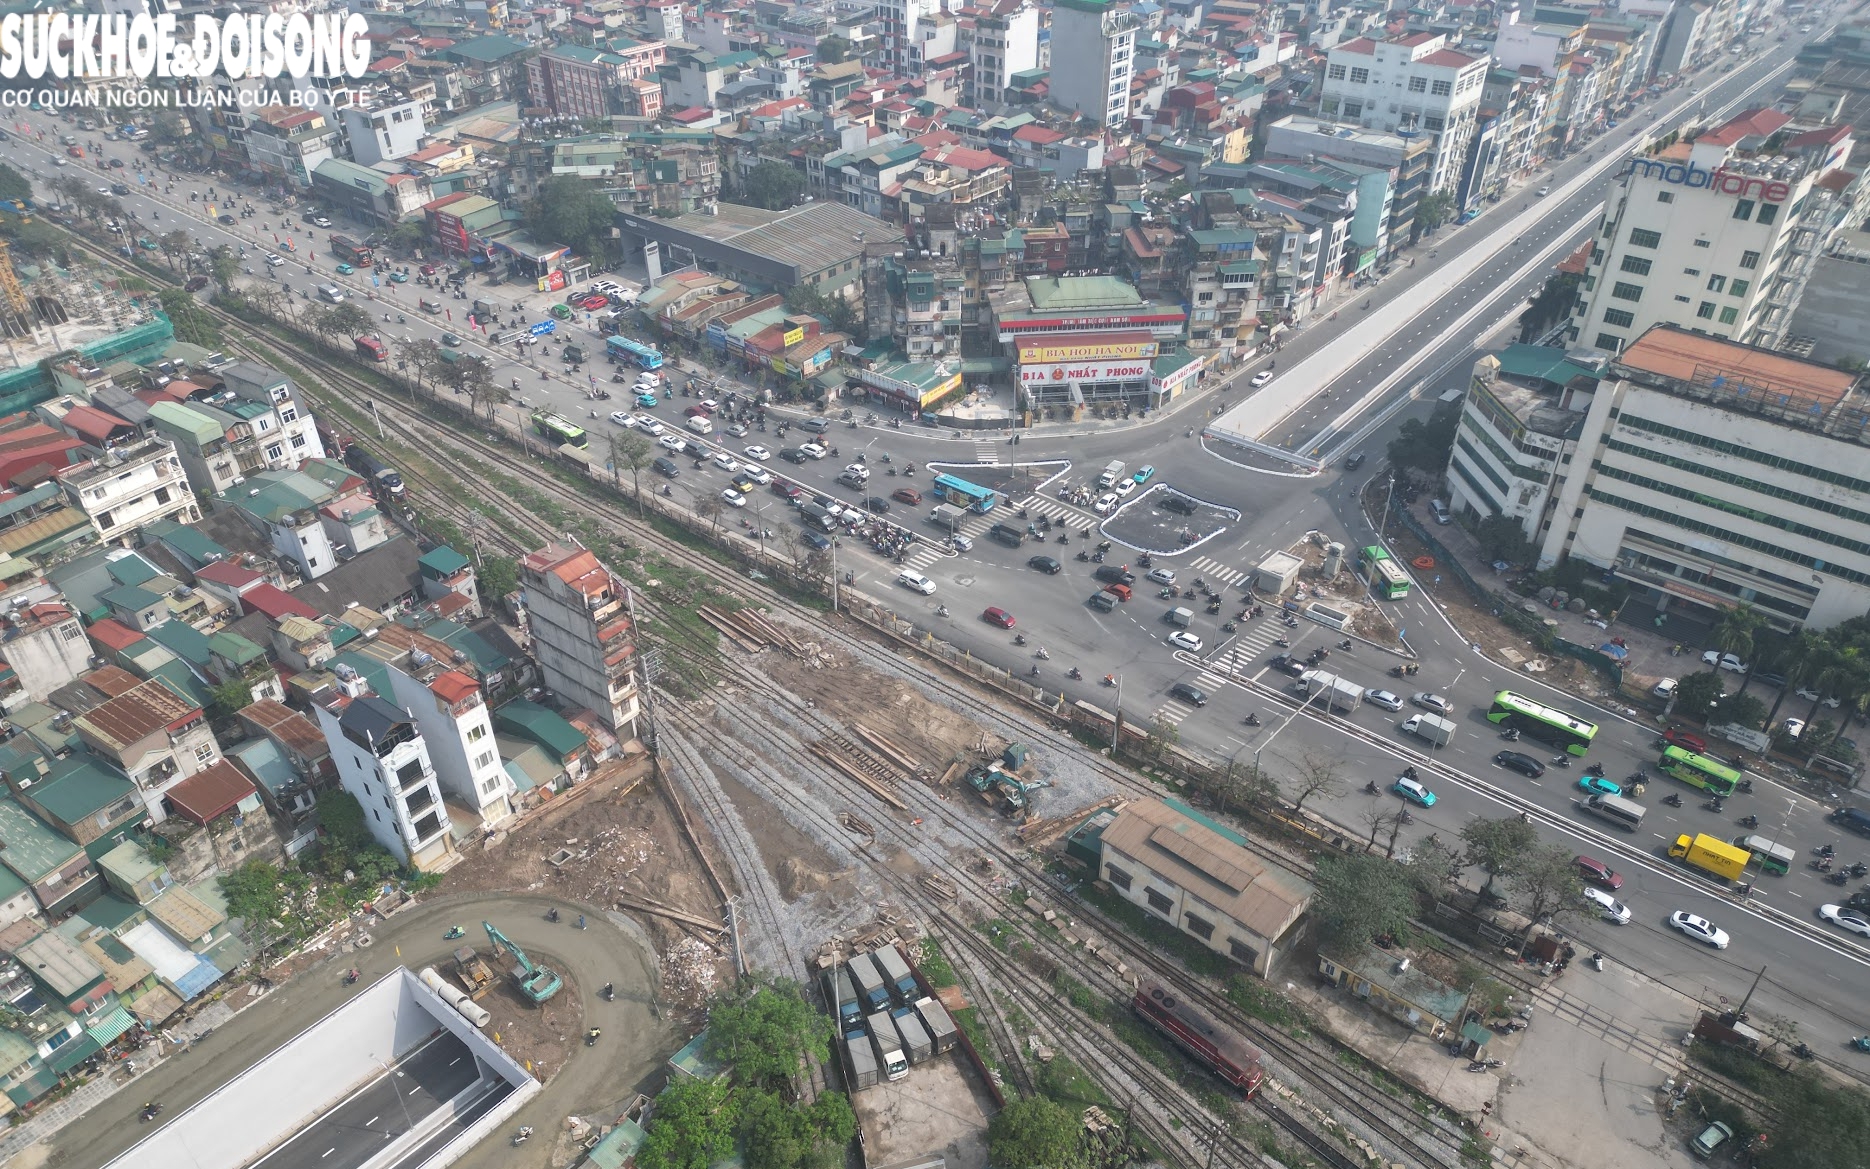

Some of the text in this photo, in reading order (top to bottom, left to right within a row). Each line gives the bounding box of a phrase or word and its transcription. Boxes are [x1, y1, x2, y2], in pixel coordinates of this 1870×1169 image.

[1631, 158, 1790, 202] mobifone
[1046, 347, 1065, 357] BIA
[1022, 365, 1144, 381] BIA NHẤT PHONG
